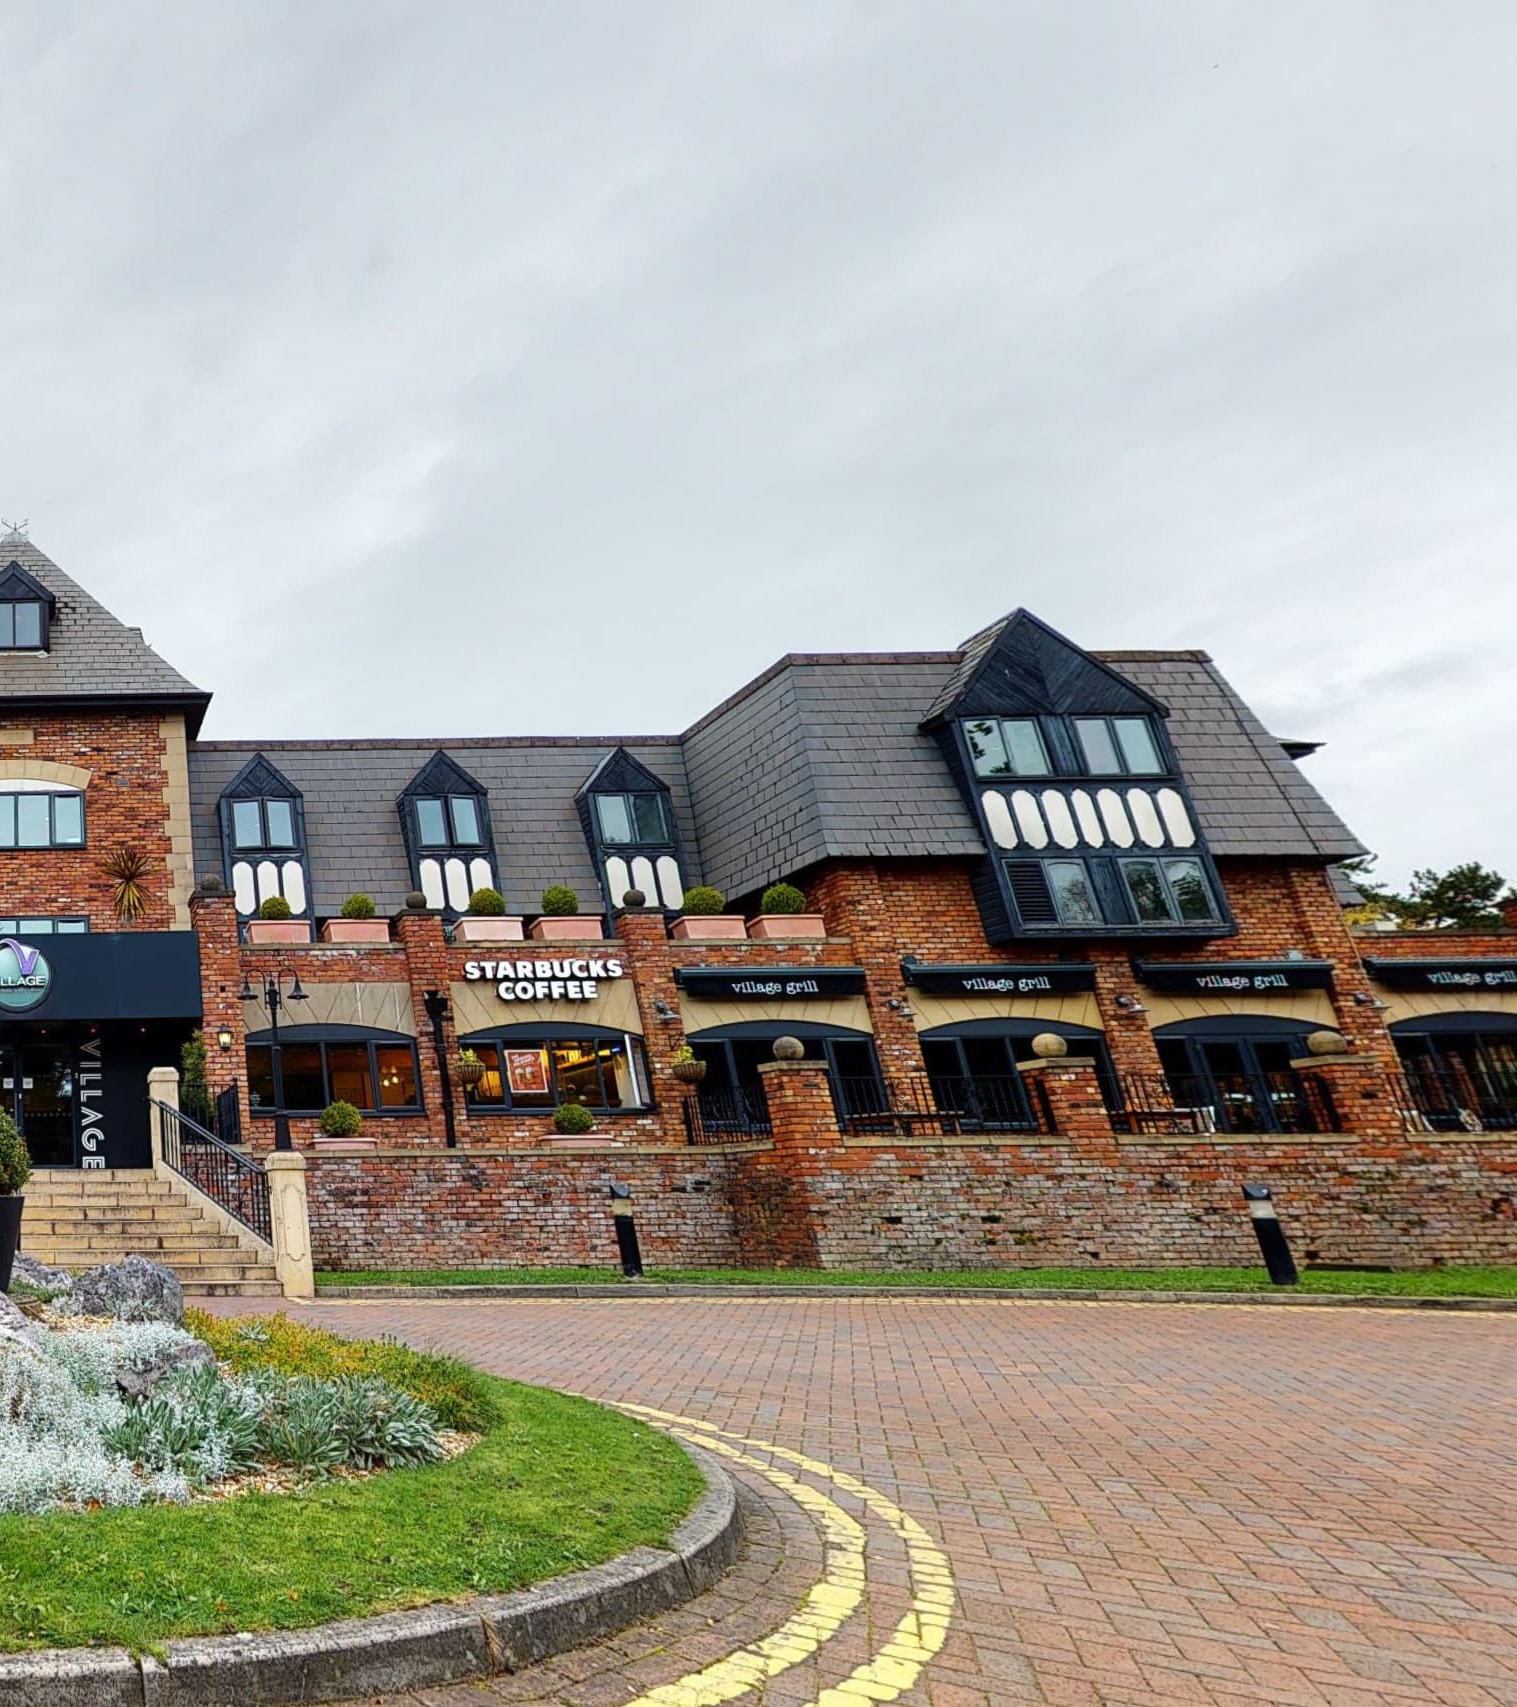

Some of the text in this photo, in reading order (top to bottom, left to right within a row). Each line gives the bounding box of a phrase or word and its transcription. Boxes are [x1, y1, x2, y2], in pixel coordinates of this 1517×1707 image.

[464, 959, 623, 980] STARBUCKS
[963, 976, 1051, 991] village grill
[1195, 974, 1289, 989] village grill
[1425, 971, 1481, 986] village
[498, 981, 598, 999] COFFEE
[731, 980, 819, 994] village grill
[80, 1039, 105, 1168] VILLAGE
